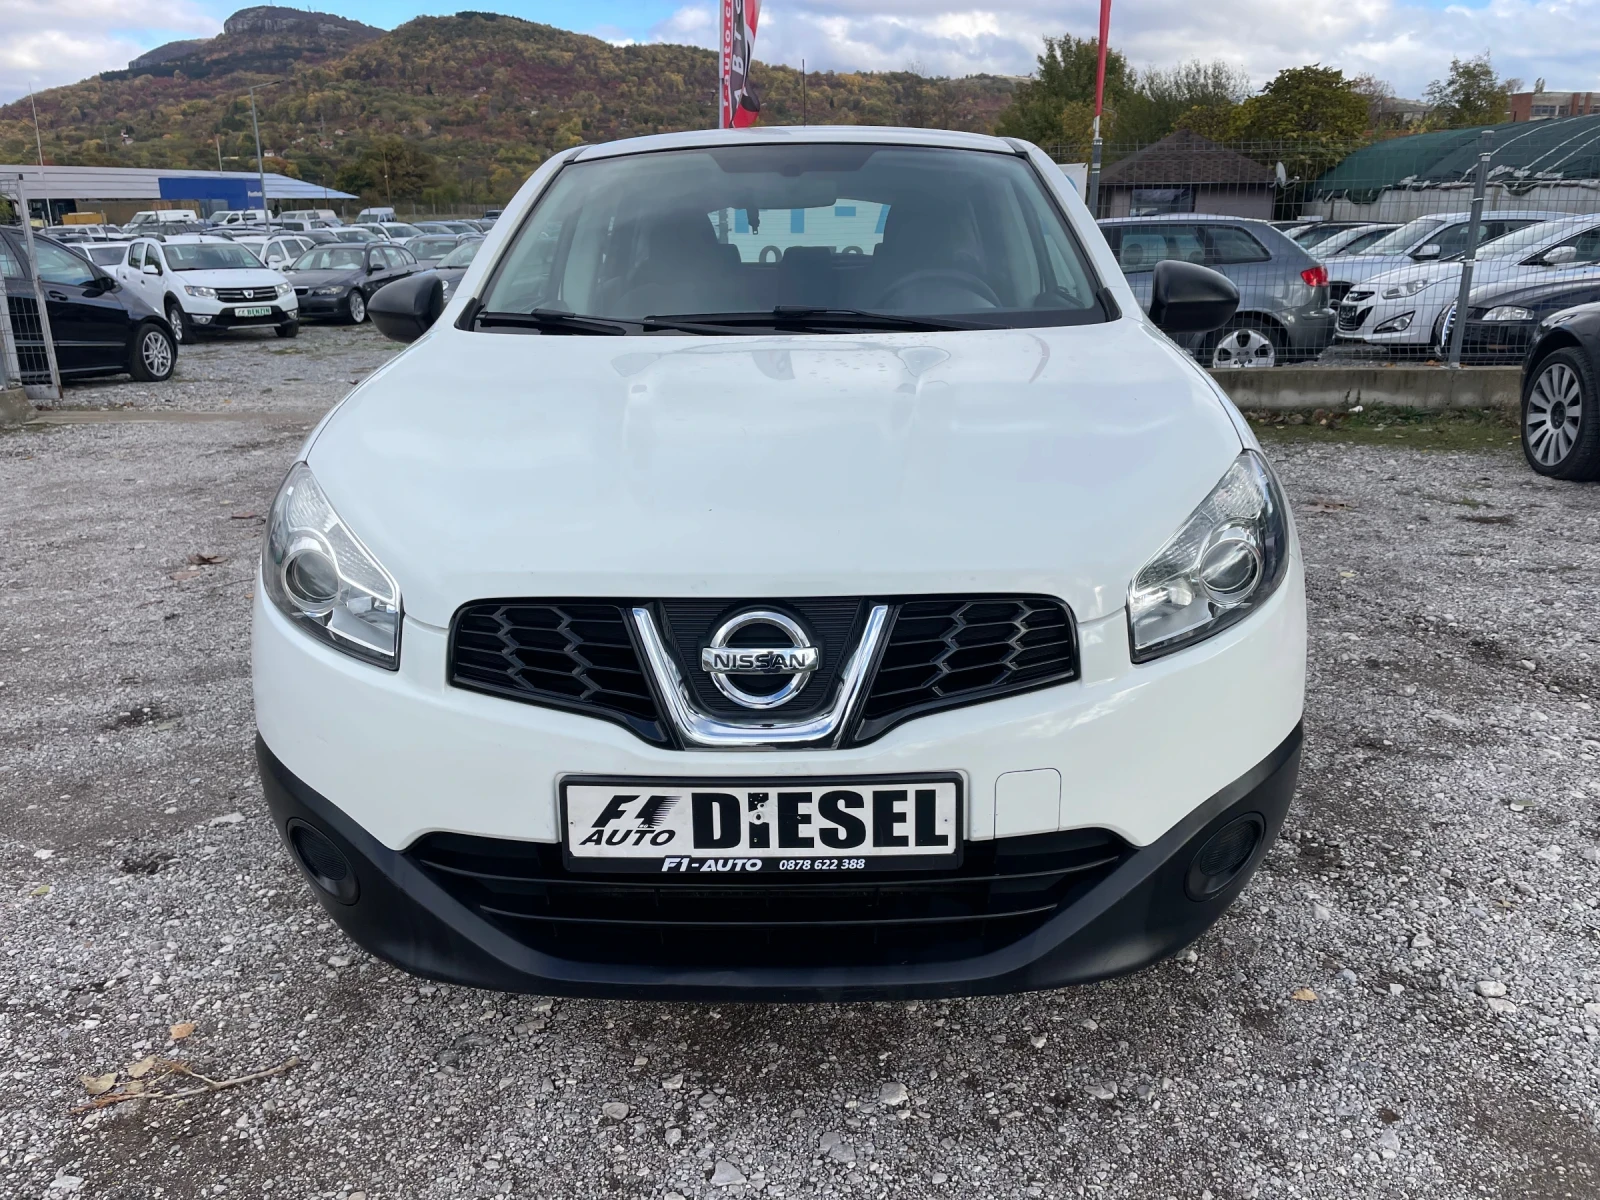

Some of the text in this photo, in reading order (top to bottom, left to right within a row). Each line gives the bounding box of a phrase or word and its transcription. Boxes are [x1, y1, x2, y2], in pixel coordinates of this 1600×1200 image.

[247, 307, 270, 315] BENZIN
[714, 652, 806, 669] NISSAN
[591, 795, 682, 828] F1
[691, 789, 949, 849] DIESEL
[578, 829, 676, 846] AUTO
[661, 857, 865, 872] F1-AUTO 0878 622 388
